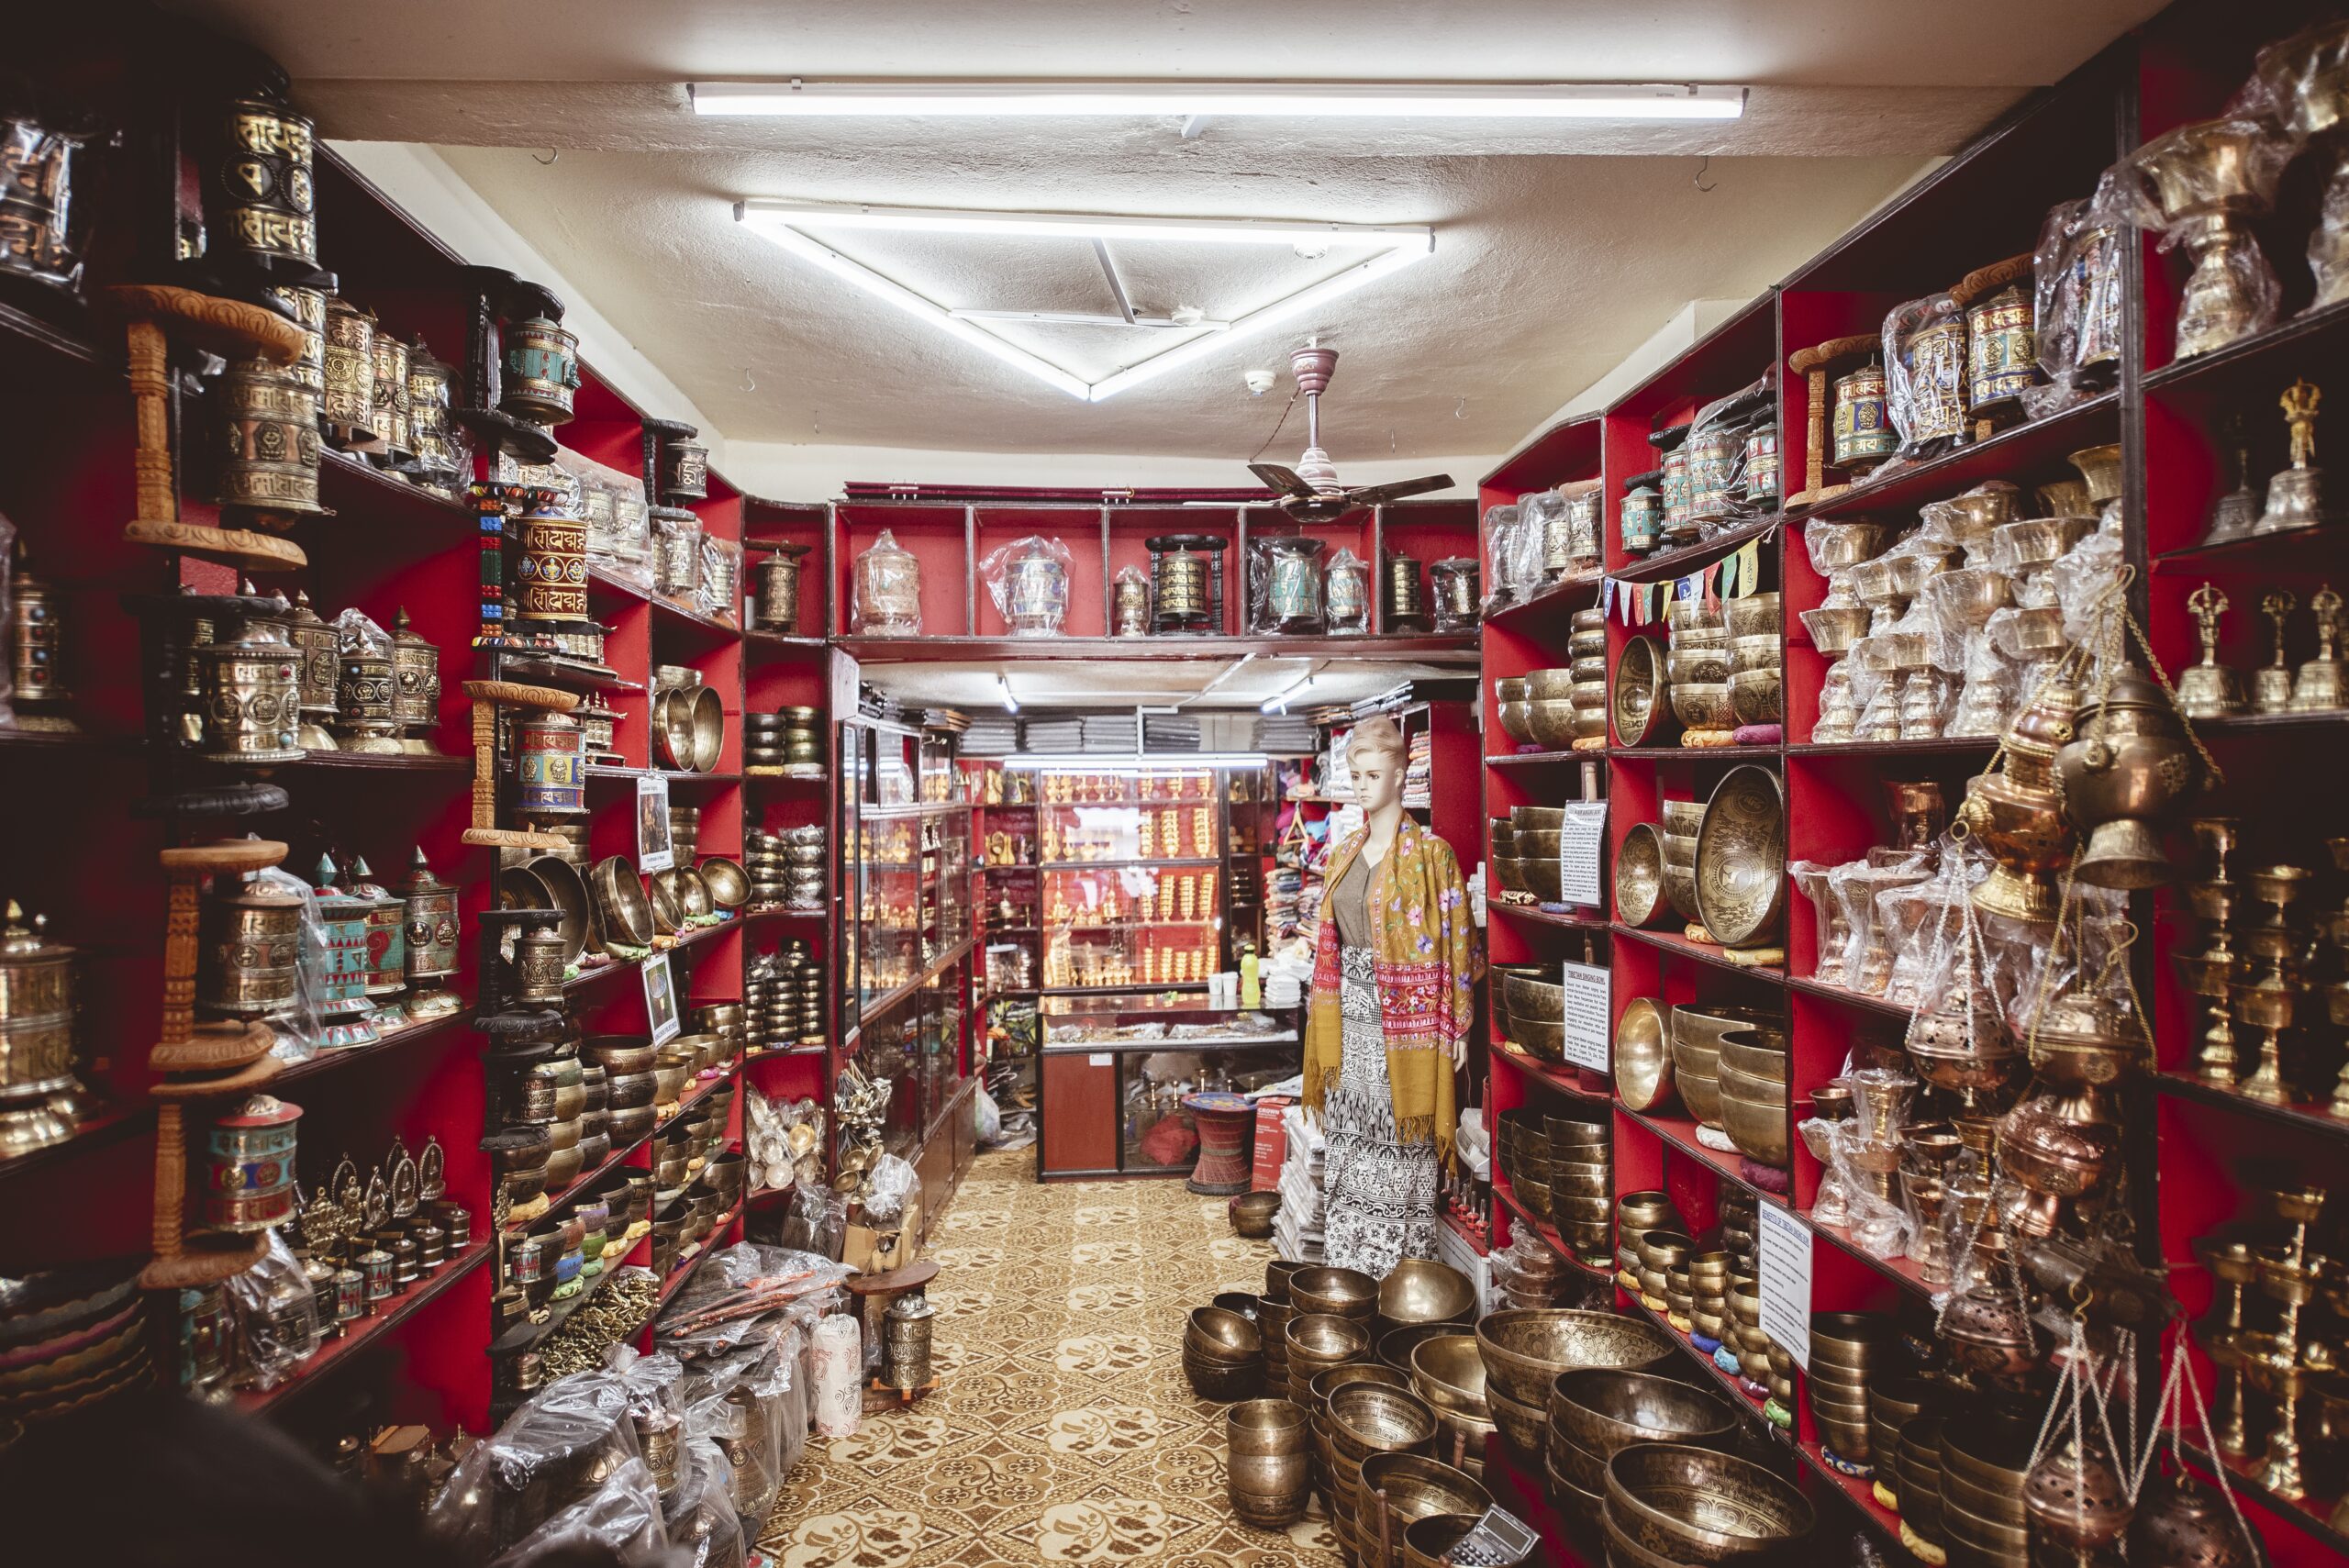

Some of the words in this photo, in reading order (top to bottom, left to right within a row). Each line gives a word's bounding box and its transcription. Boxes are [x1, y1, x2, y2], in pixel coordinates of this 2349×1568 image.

[1568, 970, 1582, 979] TIBETAN
[1583, 973, 1595, 982] SINGING
[1762, 1209, 1777, 1224] BENEFITS
[1778, 1217, 1781, 1228] OF
